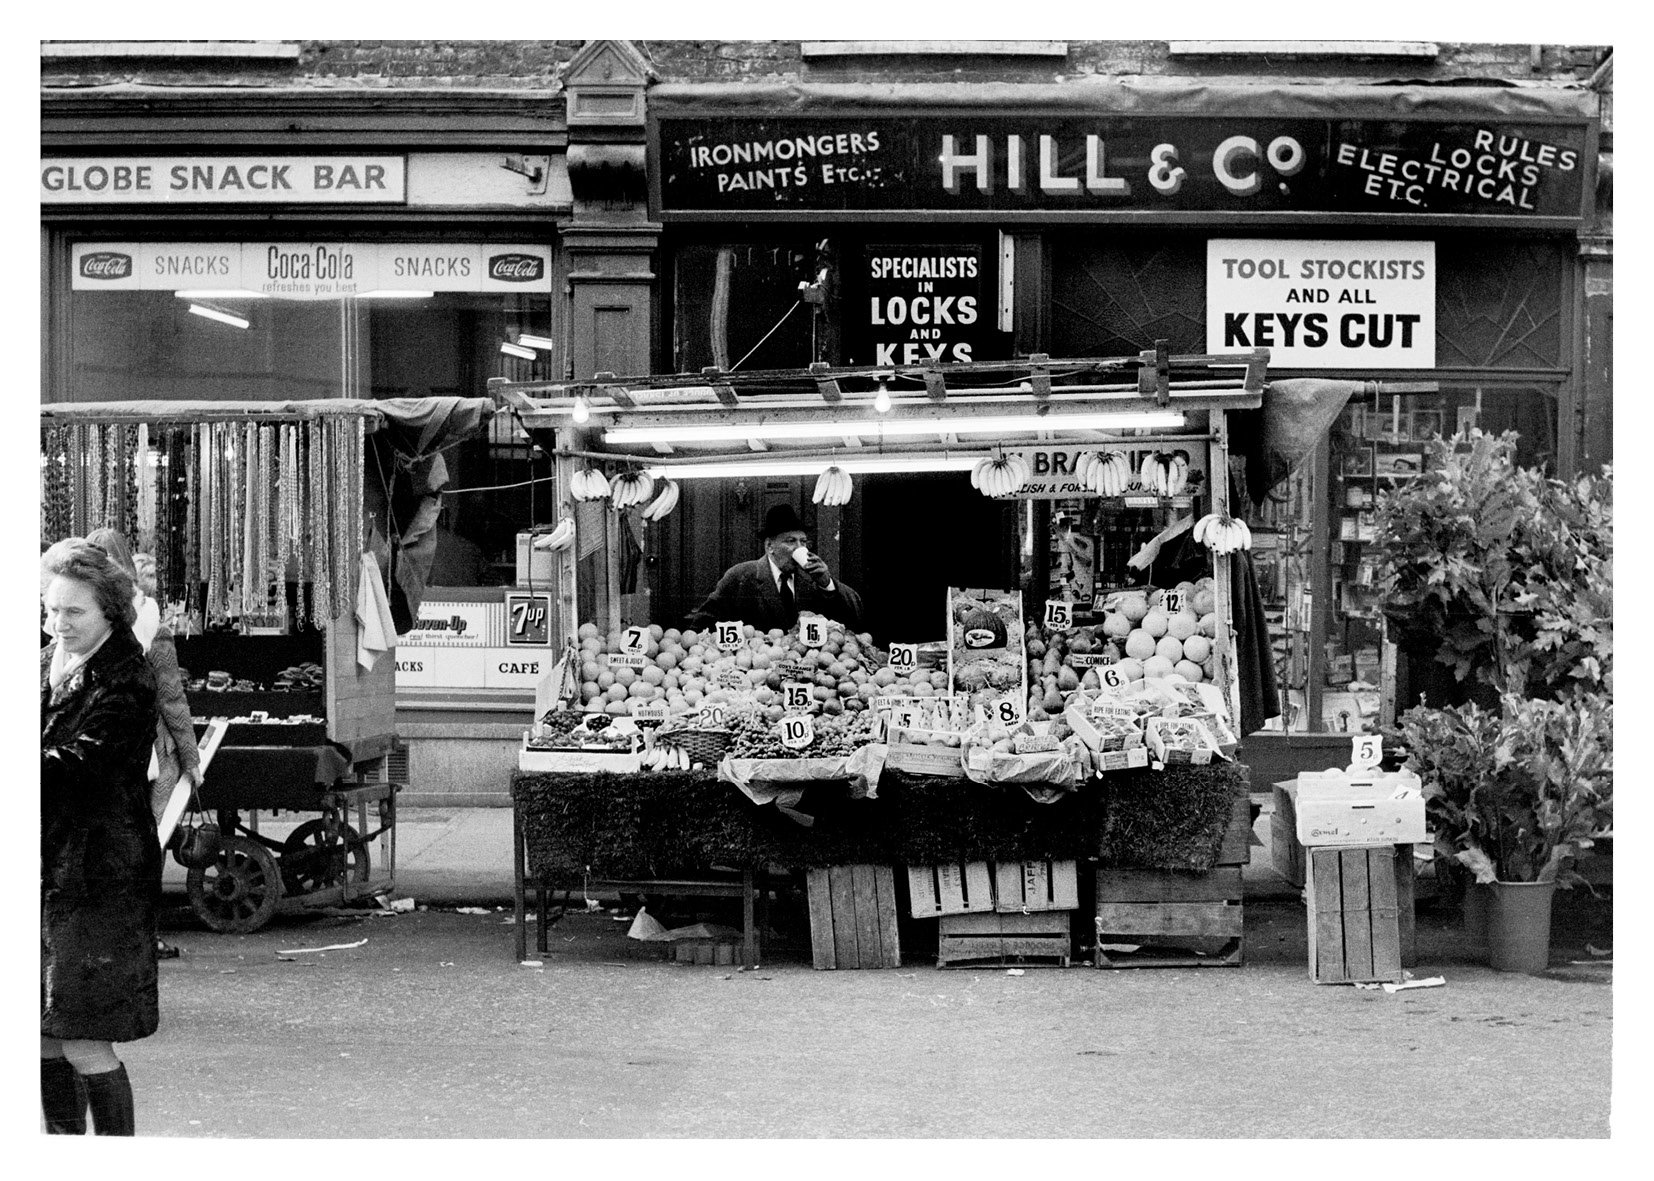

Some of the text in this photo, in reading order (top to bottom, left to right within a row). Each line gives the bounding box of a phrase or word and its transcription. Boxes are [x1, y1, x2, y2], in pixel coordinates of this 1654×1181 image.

[690, 131, 880, 168] IRONMONGERS
[942, 135, 1128, 192] HILL
[1148, 144, 1185, 190] &
[1474, 130, 1577, 170] RULES
[41, 164, 387, 192] GLOBE SNACK BAR
[1337, 143, 1534, 209] ELECTRICAL
[1431, 143, 1539, 186] LOCKS
[718, 167, 808, 193] PAINTS
[1364, 174, 1428, 208] ETC.
[154, 255, 230, 275] SNACKS
[267, 245, 353, 279] Coca-Cola
[394, 257, 471, 277] SNACKS
[870, 257, 978, 278] SPECIALISTS
[1222, 259, 1425, 280] TOOL STOCKISTS
[262, 280, 311, 293] refreshes
[315, 283, 332, 296] you
[918, 282, 933, 293] IN
[1286, 289, 1377, 304] AND ALL
[870, 296, 978, 325] LOCKS
[910, 328, 941, 340] AND
[1224, 312, 1421, 349] KEYS CUT
[876, 342, 973, 367] KEYS
[1027, 861, 1036, 894] JAFF
